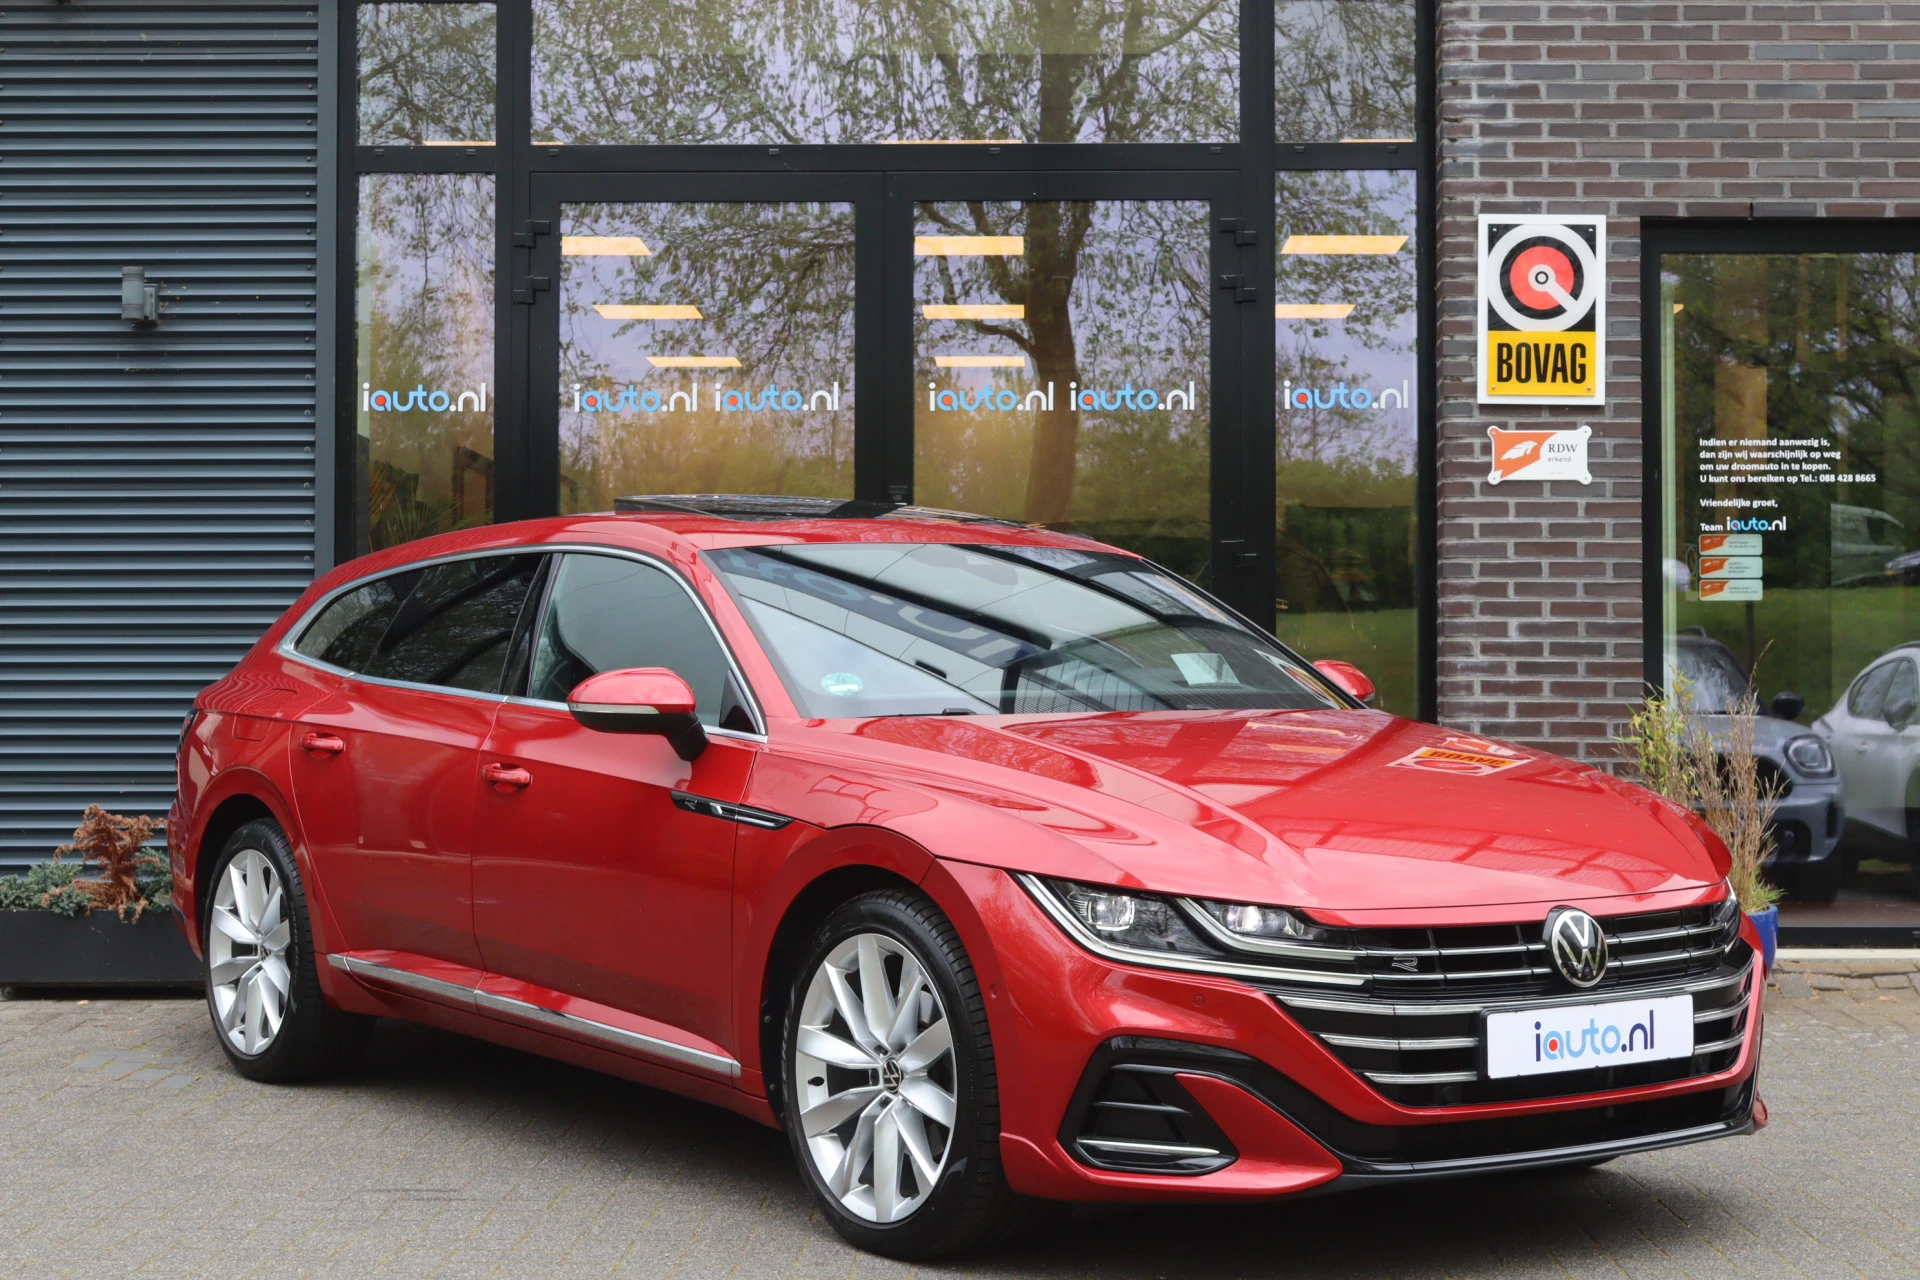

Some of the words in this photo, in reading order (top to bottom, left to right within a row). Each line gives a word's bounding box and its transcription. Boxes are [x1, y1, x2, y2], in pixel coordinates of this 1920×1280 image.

[1497, 342, 1587, 385] BOVAG
[362, 382, 487, 412] iauto.nl
[573, 383, 698, 413] iauto.nl
[714, 381, 839, 412] iauto.nl
[928, 381, 1054, 412] iauto.nl
[1069, 380, 1195, 411] iauto.nl
[1283, 379, 1409, 409] iauto.nl
[1548, 443, 1578, 453] RDW
[1700, 438, 1727, 447] Indien
[1740, 438, 1777, 447] niemand
[1779, 438, 1819, 448] aanwezig
[1820, 438, 1831, 448] is,
[1700, 450, 1716, 459] dan
[1718, 450, 1733, 460] zijn
[1734, 450, 1748, 460] wij
[1750, 450, 1808, 460] waarschijnlijk
[1809, 452, 1822, 460] op
[1823, 452, 1842, 460] weg
[1700, 463, 1714, 471] om
[1731, 462, 1779, 471] droomauto
[1781, 462, 1790, 471] in
[1791, 462, 1800, 471] te
[1802, 462, 1832, 472] kopen.
[1700, 474, 1707, 483] U
[1708, 474, 1729, 483] kunt
[1747, 474, 1785, 483] bereiken
[1786, 476, 1798, 484] op
[1800, 474, 1818, 483] Tel.:
[1819, 474, 1836, 483] 088
[1837, 474, 1853, 483] 428
[1855, 474, 1877, 483] 8665
[1700, 499, 1751, 509] Vriendelijke
[1752, 499, 1779, 508] groet,
[1700, 523, 1723, 531] Team
[1726, 516, 1787, 531] iauto.nl
[1534, 1009, 1655, 1063] iauto.nl
